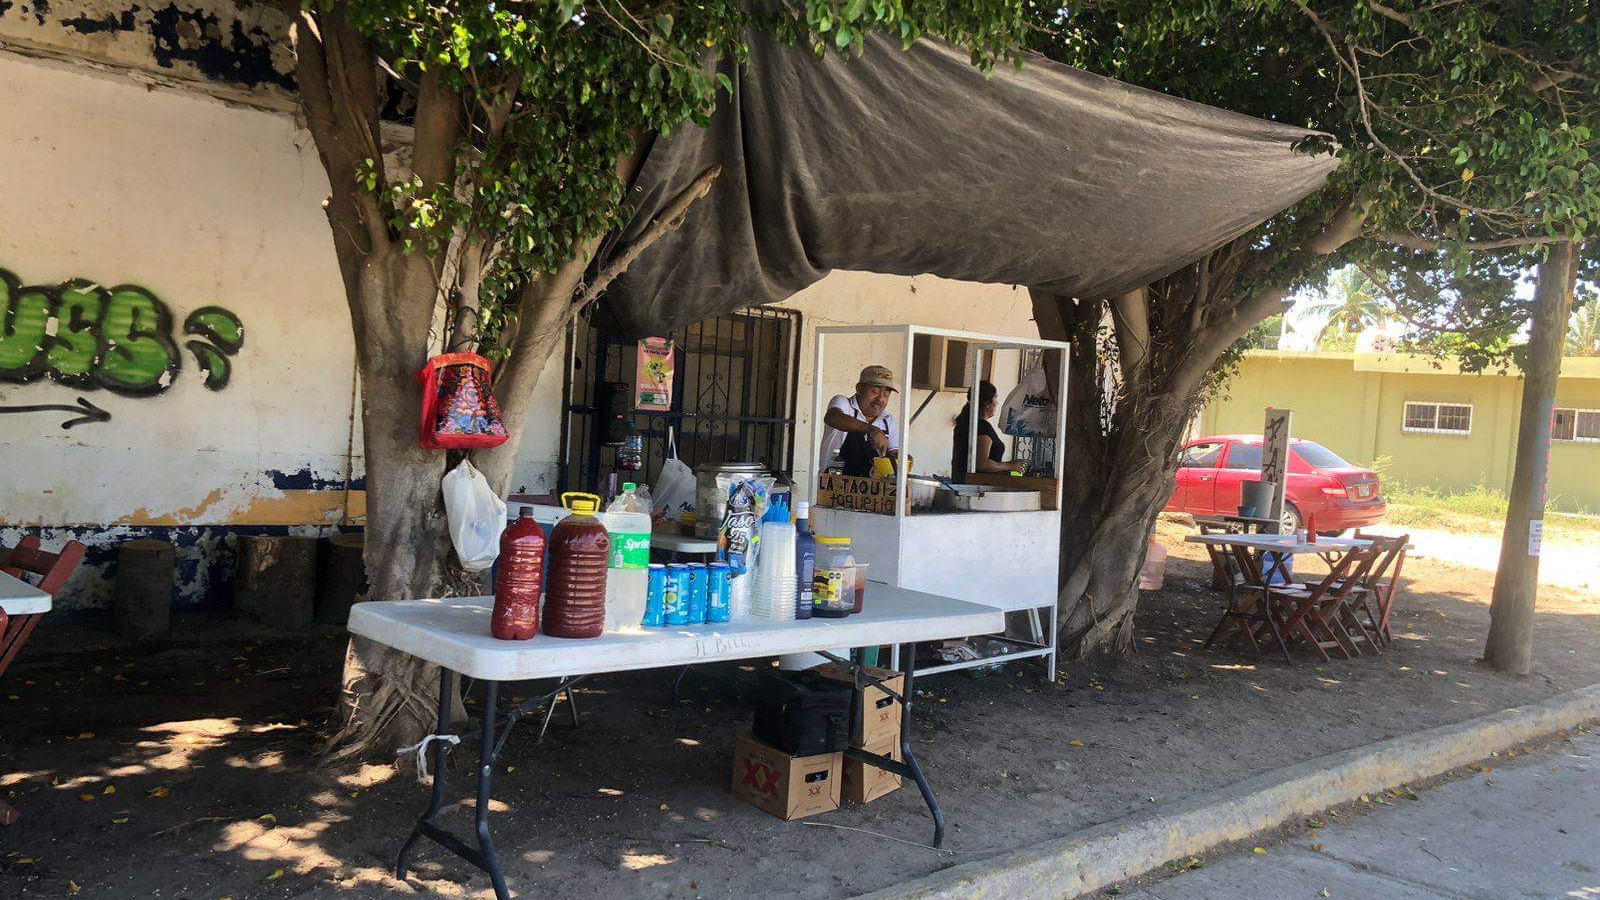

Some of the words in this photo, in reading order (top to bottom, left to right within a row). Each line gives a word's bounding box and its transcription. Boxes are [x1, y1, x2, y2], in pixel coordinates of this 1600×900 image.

[1023, 394, 1049, 406] Neto
[819, 476, 834, 490] LA
[808, 785, 822, 796] XX
